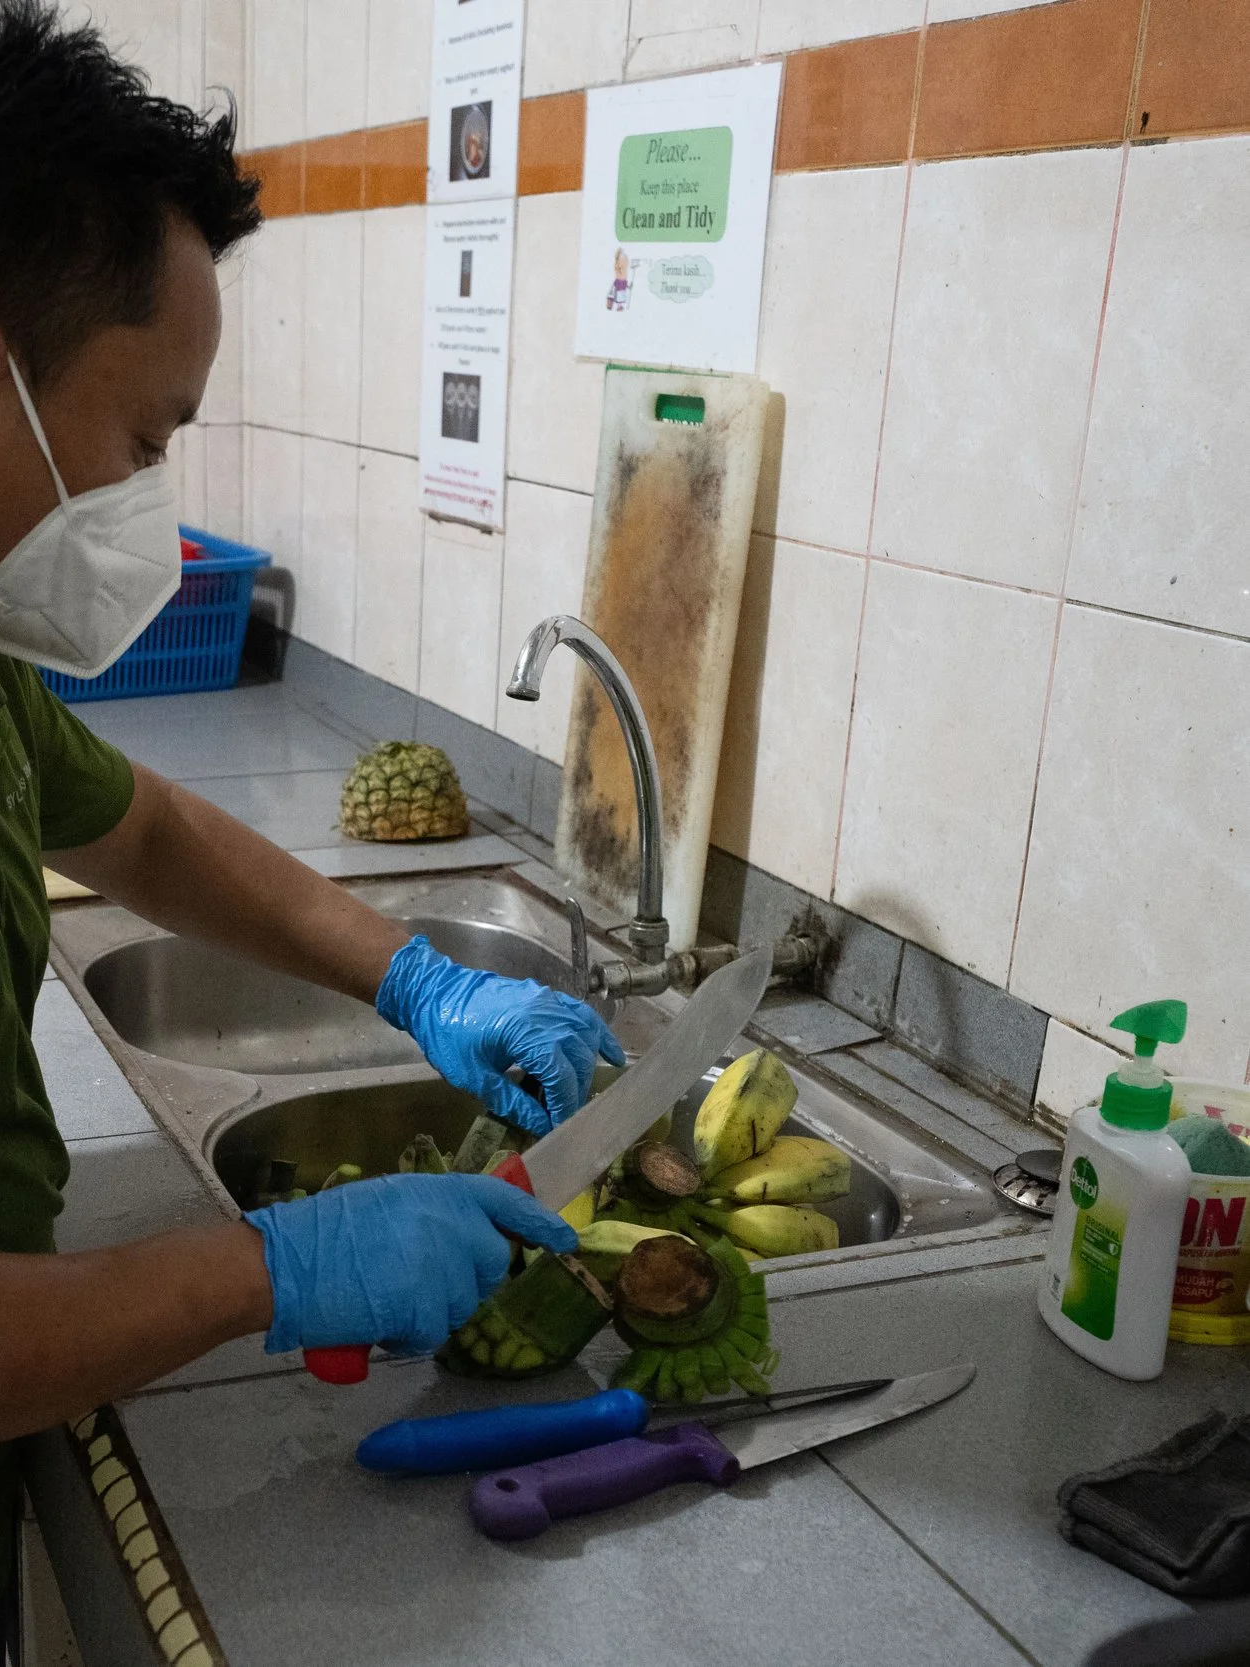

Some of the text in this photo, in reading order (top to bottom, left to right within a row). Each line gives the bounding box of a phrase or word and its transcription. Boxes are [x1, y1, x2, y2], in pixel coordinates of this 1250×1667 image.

[645, 138, 701, 164] Please...
[640, 178, 700, 199] Keep this place
[622, 205, 716, 234] Clean and Tidy
[1070, 1168, 1097, 1199] Dettol
[1177, 1275, 1215, 1287] MUDAH
